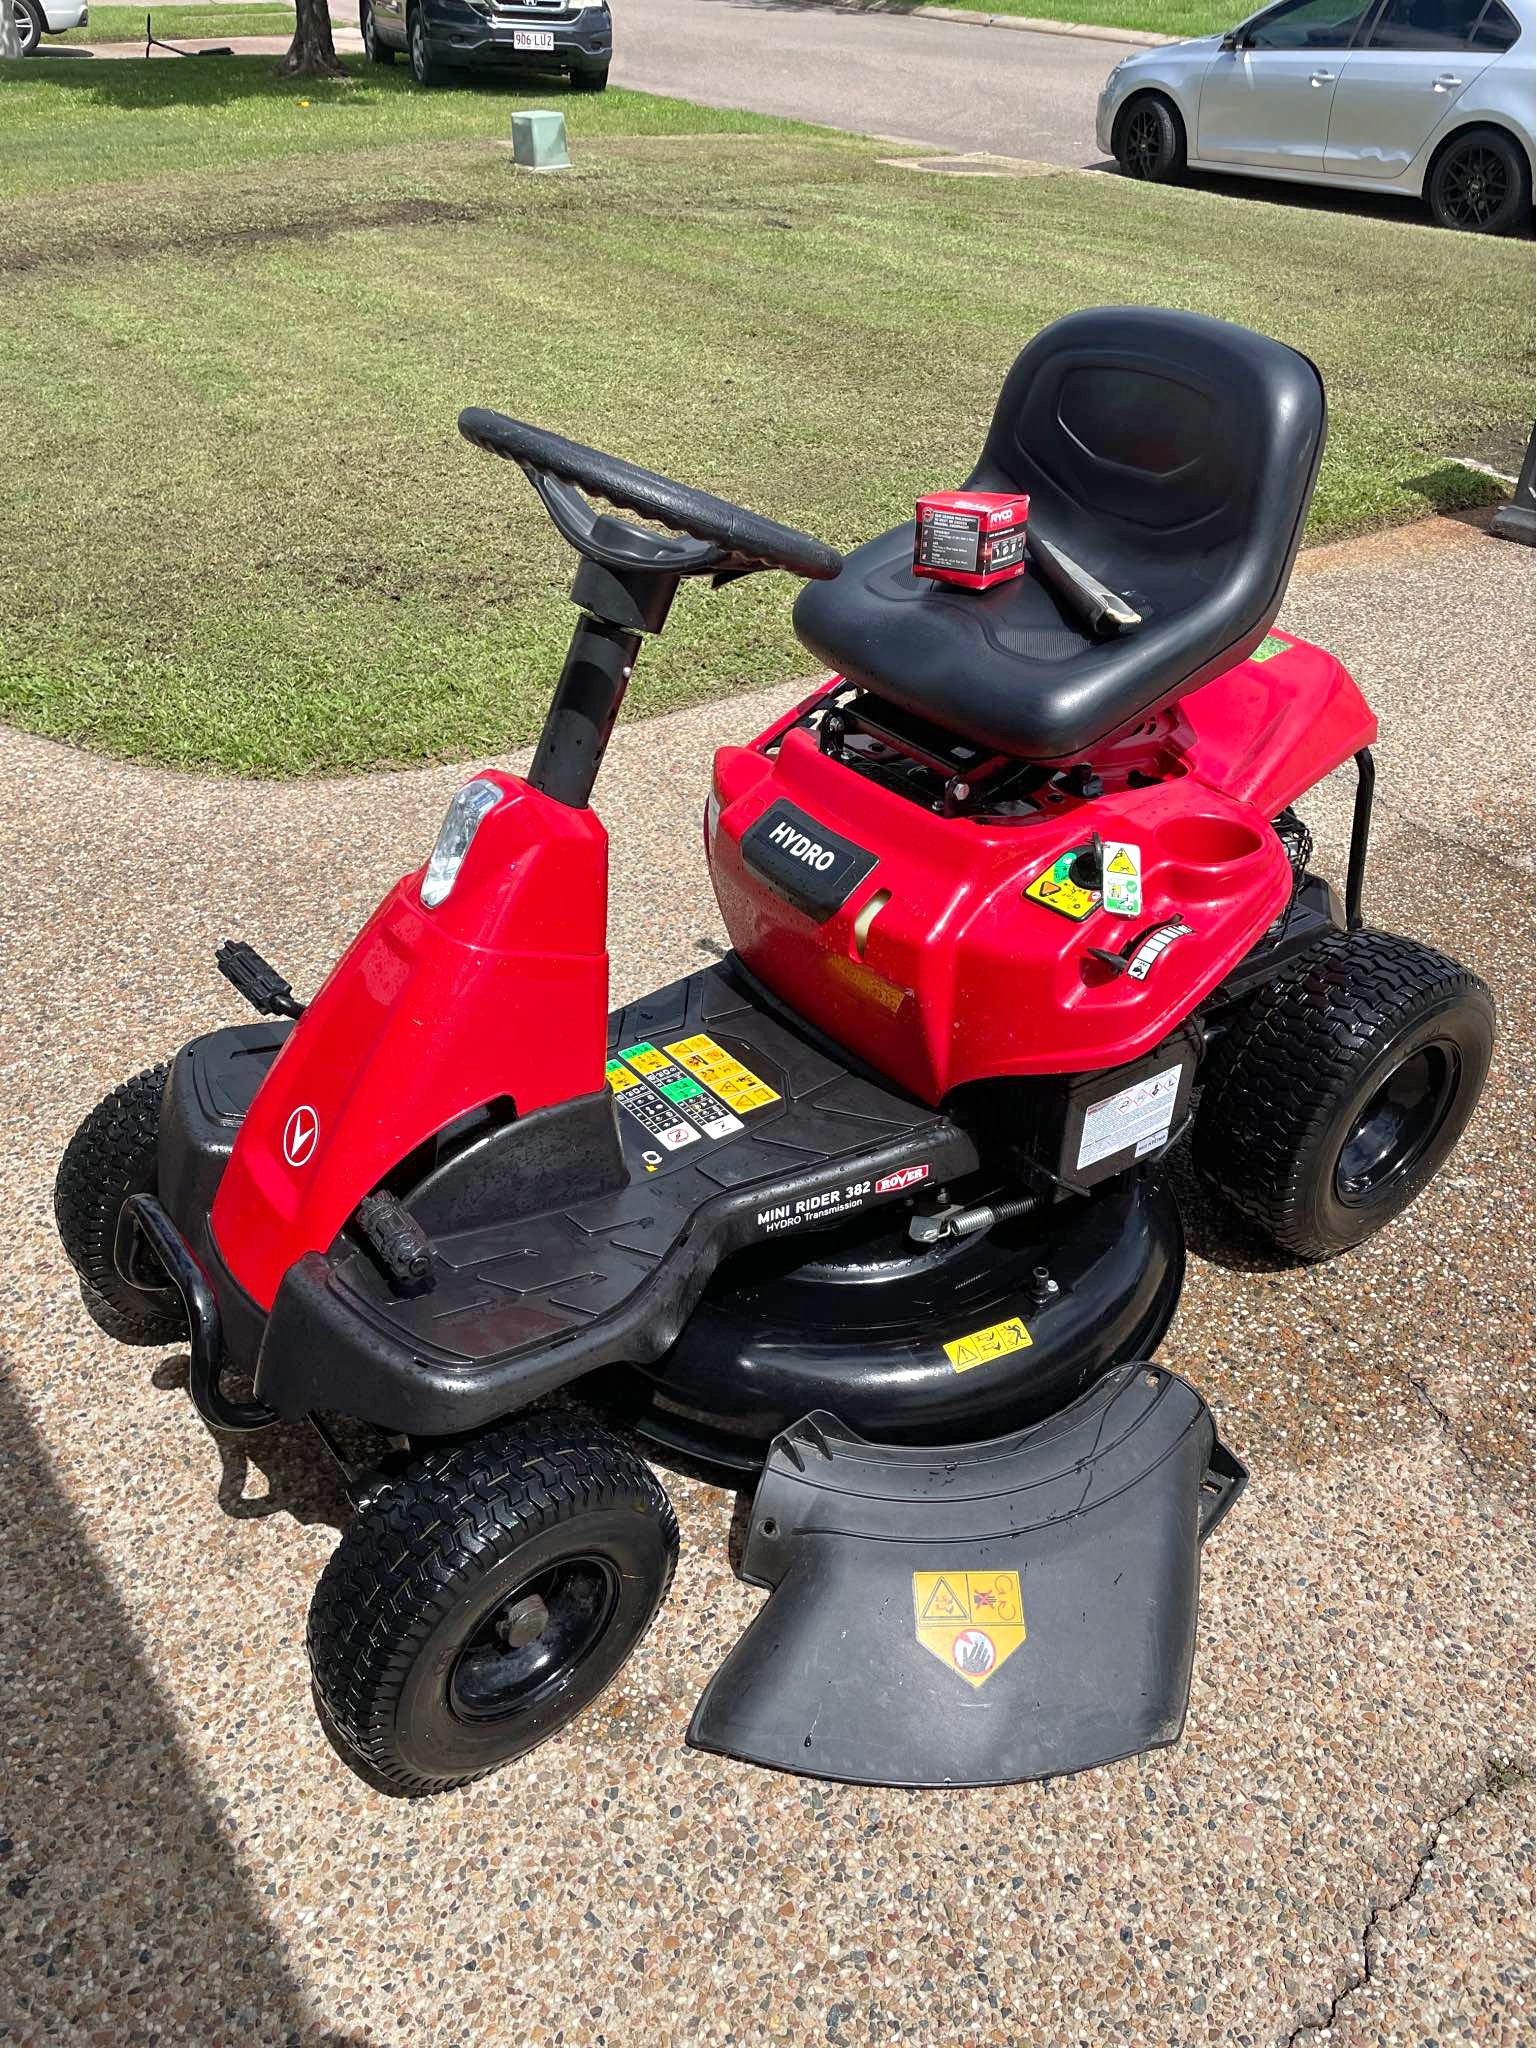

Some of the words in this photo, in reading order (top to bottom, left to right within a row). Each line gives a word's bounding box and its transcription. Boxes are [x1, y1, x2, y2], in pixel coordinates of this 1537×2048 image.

[990, 509, 1013, 524] RYCO
[768, 821, 835, 871] HYDRO
[881, 1168, 923, 1190] ROVER
[757, 1205, 790, 1225] MINI
[795, 1190, 841, 1214] RIDER
[845, 1181, 871, 1198] 382
[766, 1215, 802, 1233] HYDRO
[804, 1198, 863, 1222] Transmission
